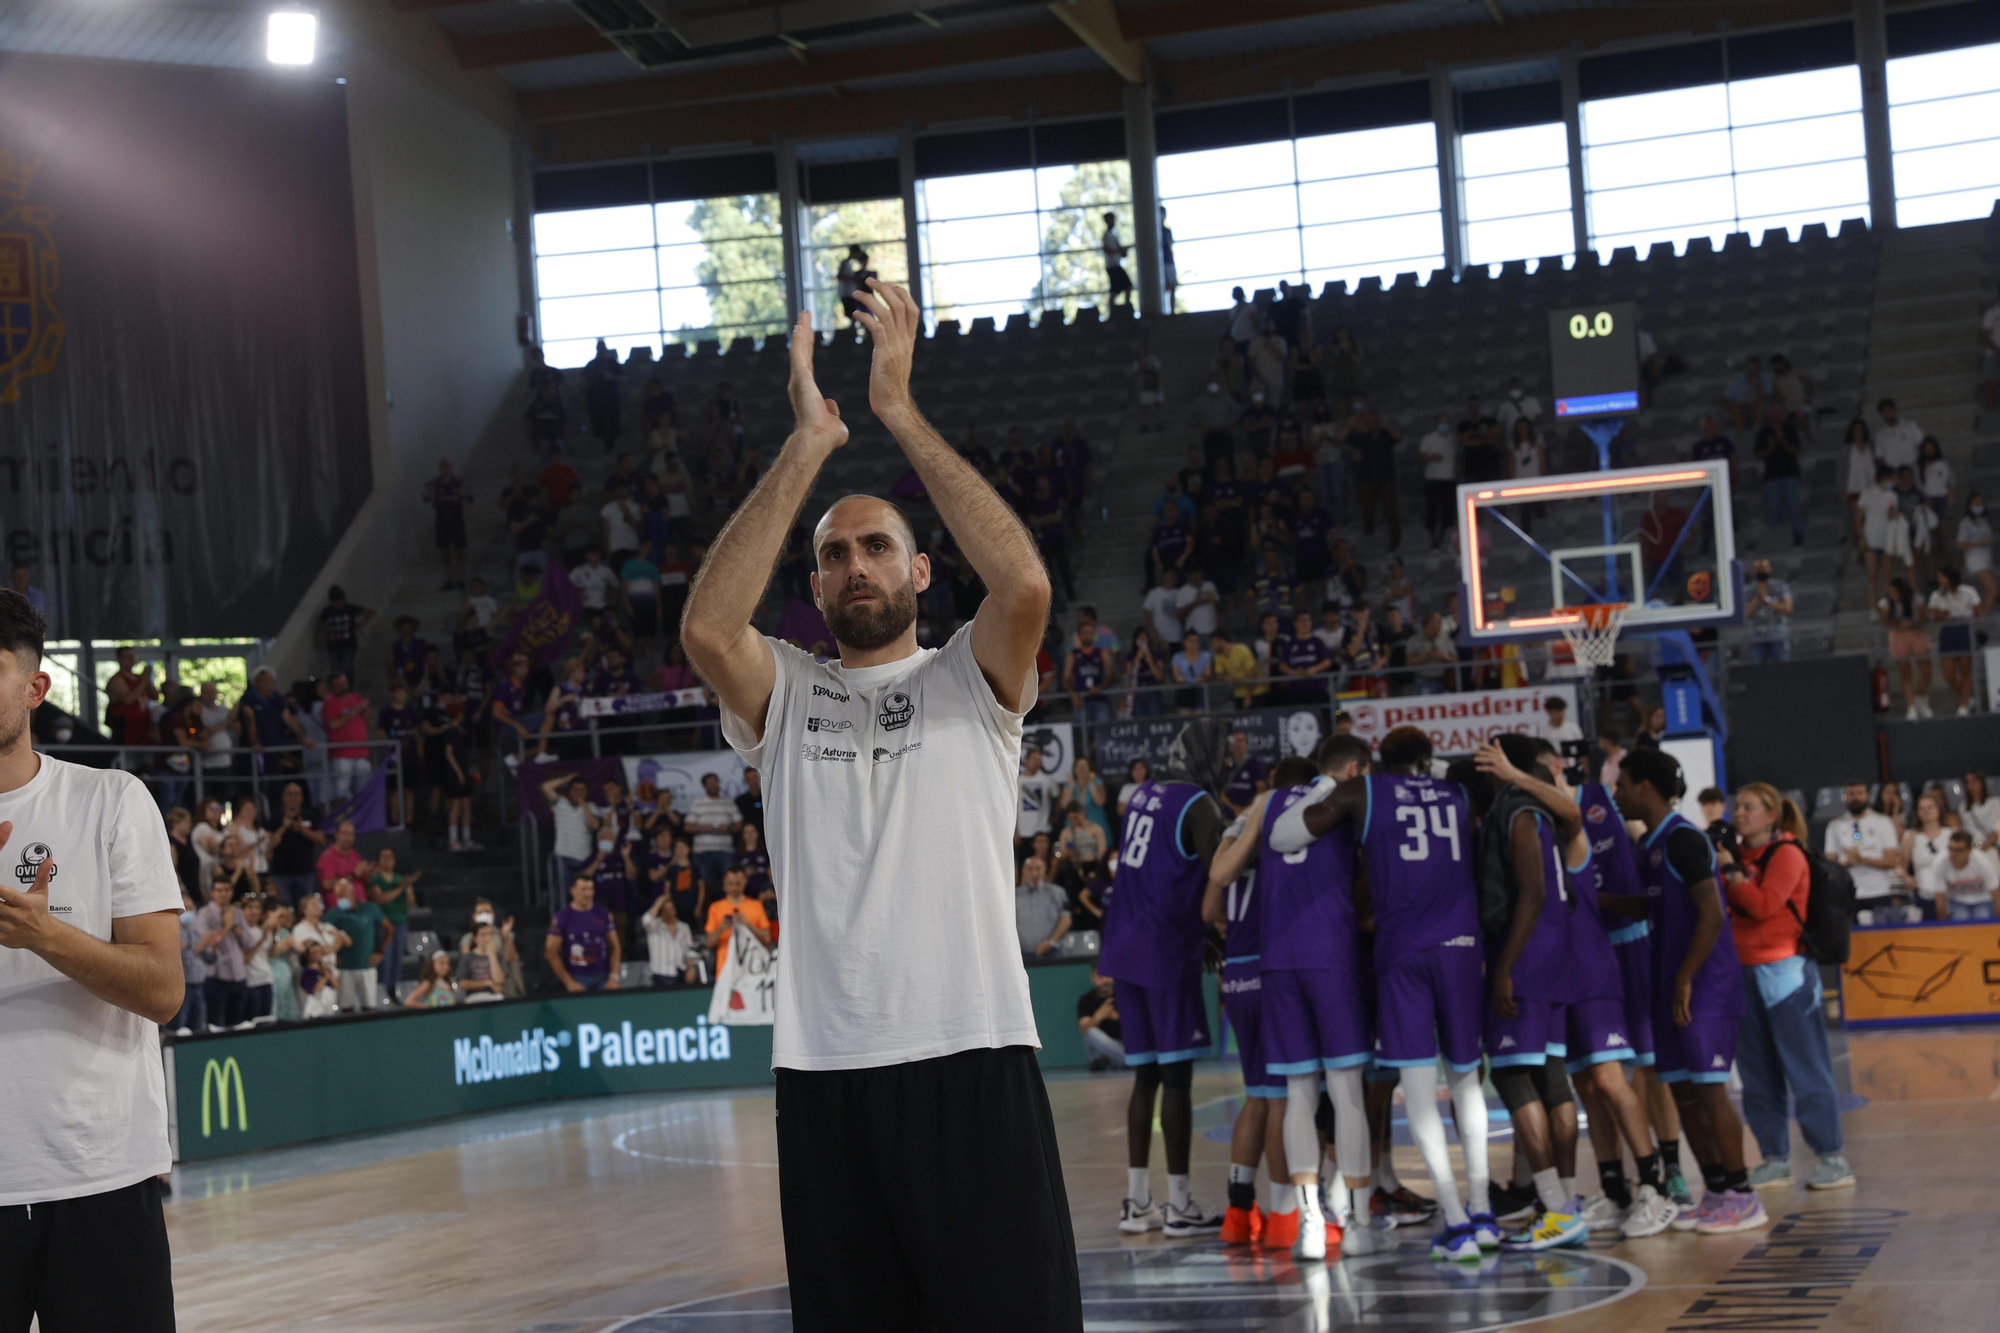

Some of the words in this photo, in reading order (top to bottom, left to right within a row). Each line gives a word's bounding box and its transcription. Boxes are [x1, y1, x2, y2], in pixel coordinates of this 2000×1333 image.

[1569, 312, 1613, 339] 0.0
[812, 685, 851, 703] SPALDI
[1384, 691, 1547, 728] panaderí
[1395, 805, 1460, 861] 34
[16, 866, 57, 876] OVIO
[577, 1015, 731, 1068] Palencia
